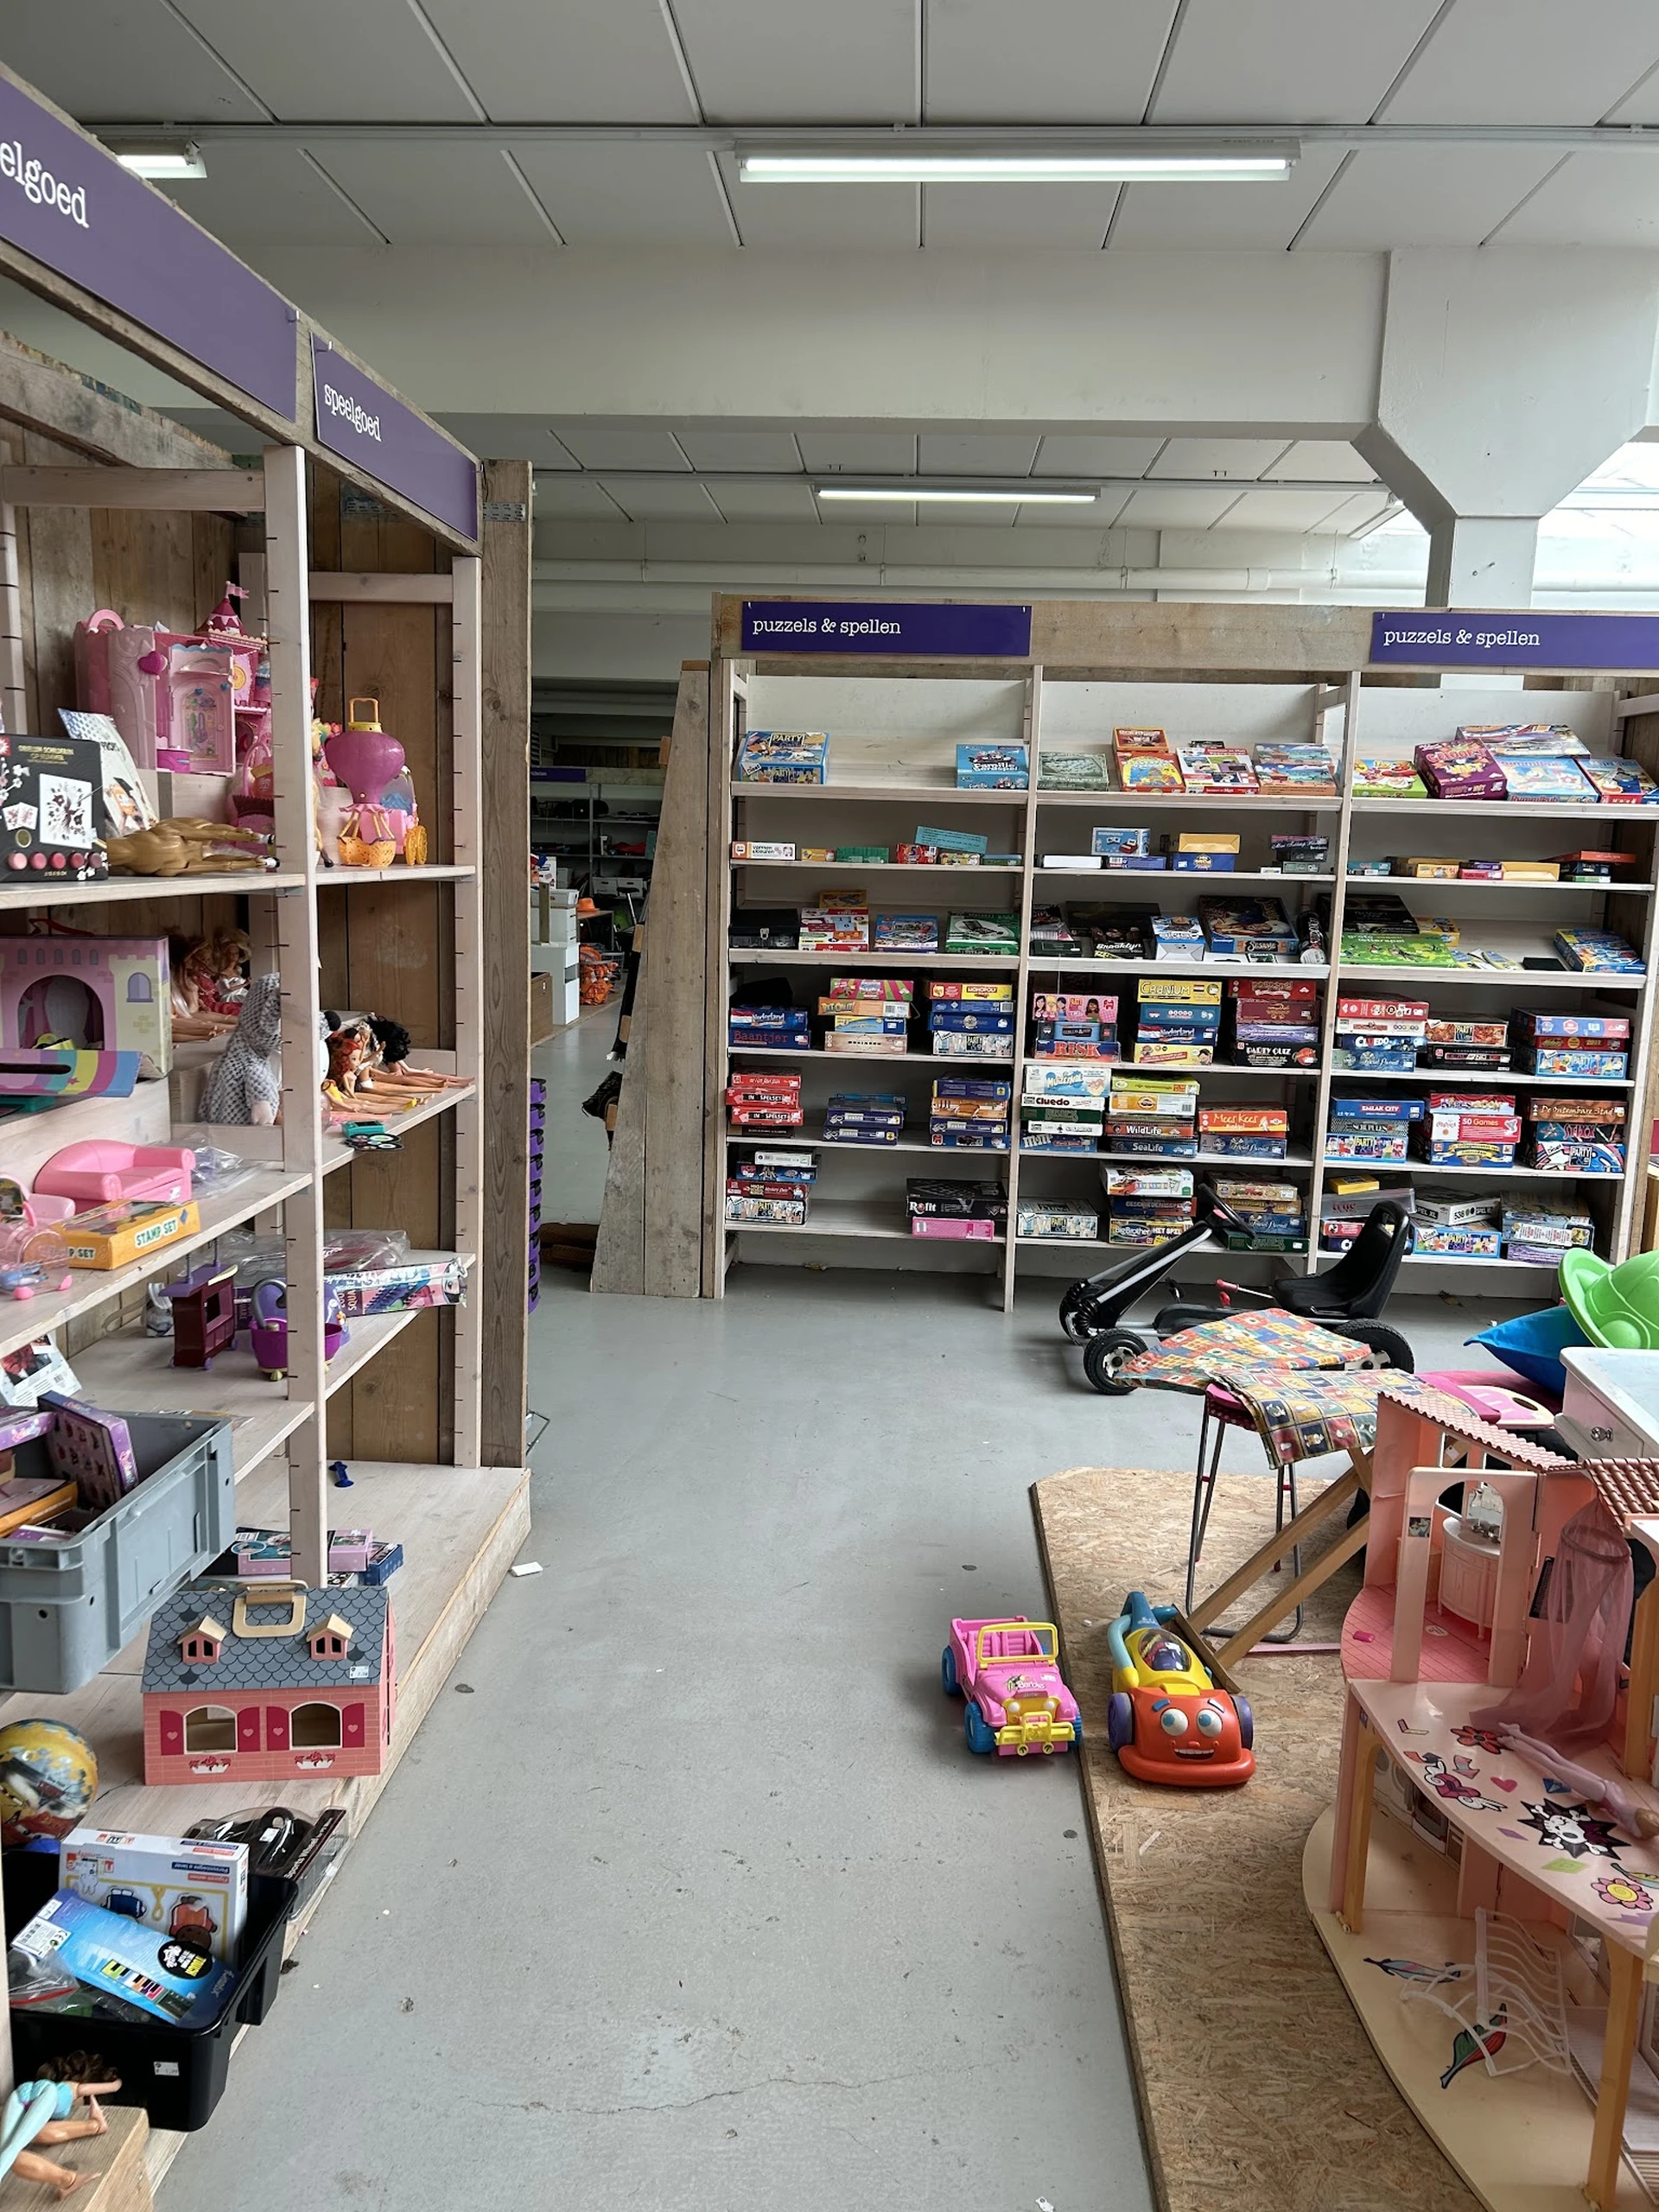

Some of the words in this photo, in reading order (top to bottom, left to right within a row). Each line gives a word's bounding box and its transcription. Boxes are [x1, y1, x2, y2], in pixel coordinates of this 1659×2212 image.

[0, 140, 90, 229] elgoed
[324, 382, 382, 442] speelgoed
[752, 618, 817, 636] puzzels
[820, 618, 836, 633] &
[840, 620, 901, 637] spellen
[1383, 629, 1452, 647] puzzels
[1455, 629, 1472, 645] &
[1476, 631, 1541, 648] spellen
[1096, 942, 1141, 950] Brooklyn
[751, 1013, 785, 1022] Nederland
[734, 1030, 788, 1043] Baantjer
[1160, 1027, 1195, 1037] Nederland
[1054, 1041, 1101, 1057] RISK
[1036, 1097, 1070, 1106] Cluedo
[1594, 1107, 1613, 1116] Stad
[1213, 1113, 1236, 1124] Mees
[1238, 1113, 1259, 1123] Kees
[1126, 1125, 1162, 1135] WildLife
[1132, 1142, 1164, 1152] SeaLife
[1571, 1147, 1592, 1158] PARTY
[136, 1226, 162, 1247] STAMP
[163, 1219, 178, 1236] SET
[77, 1249, 94, 1259] SET
